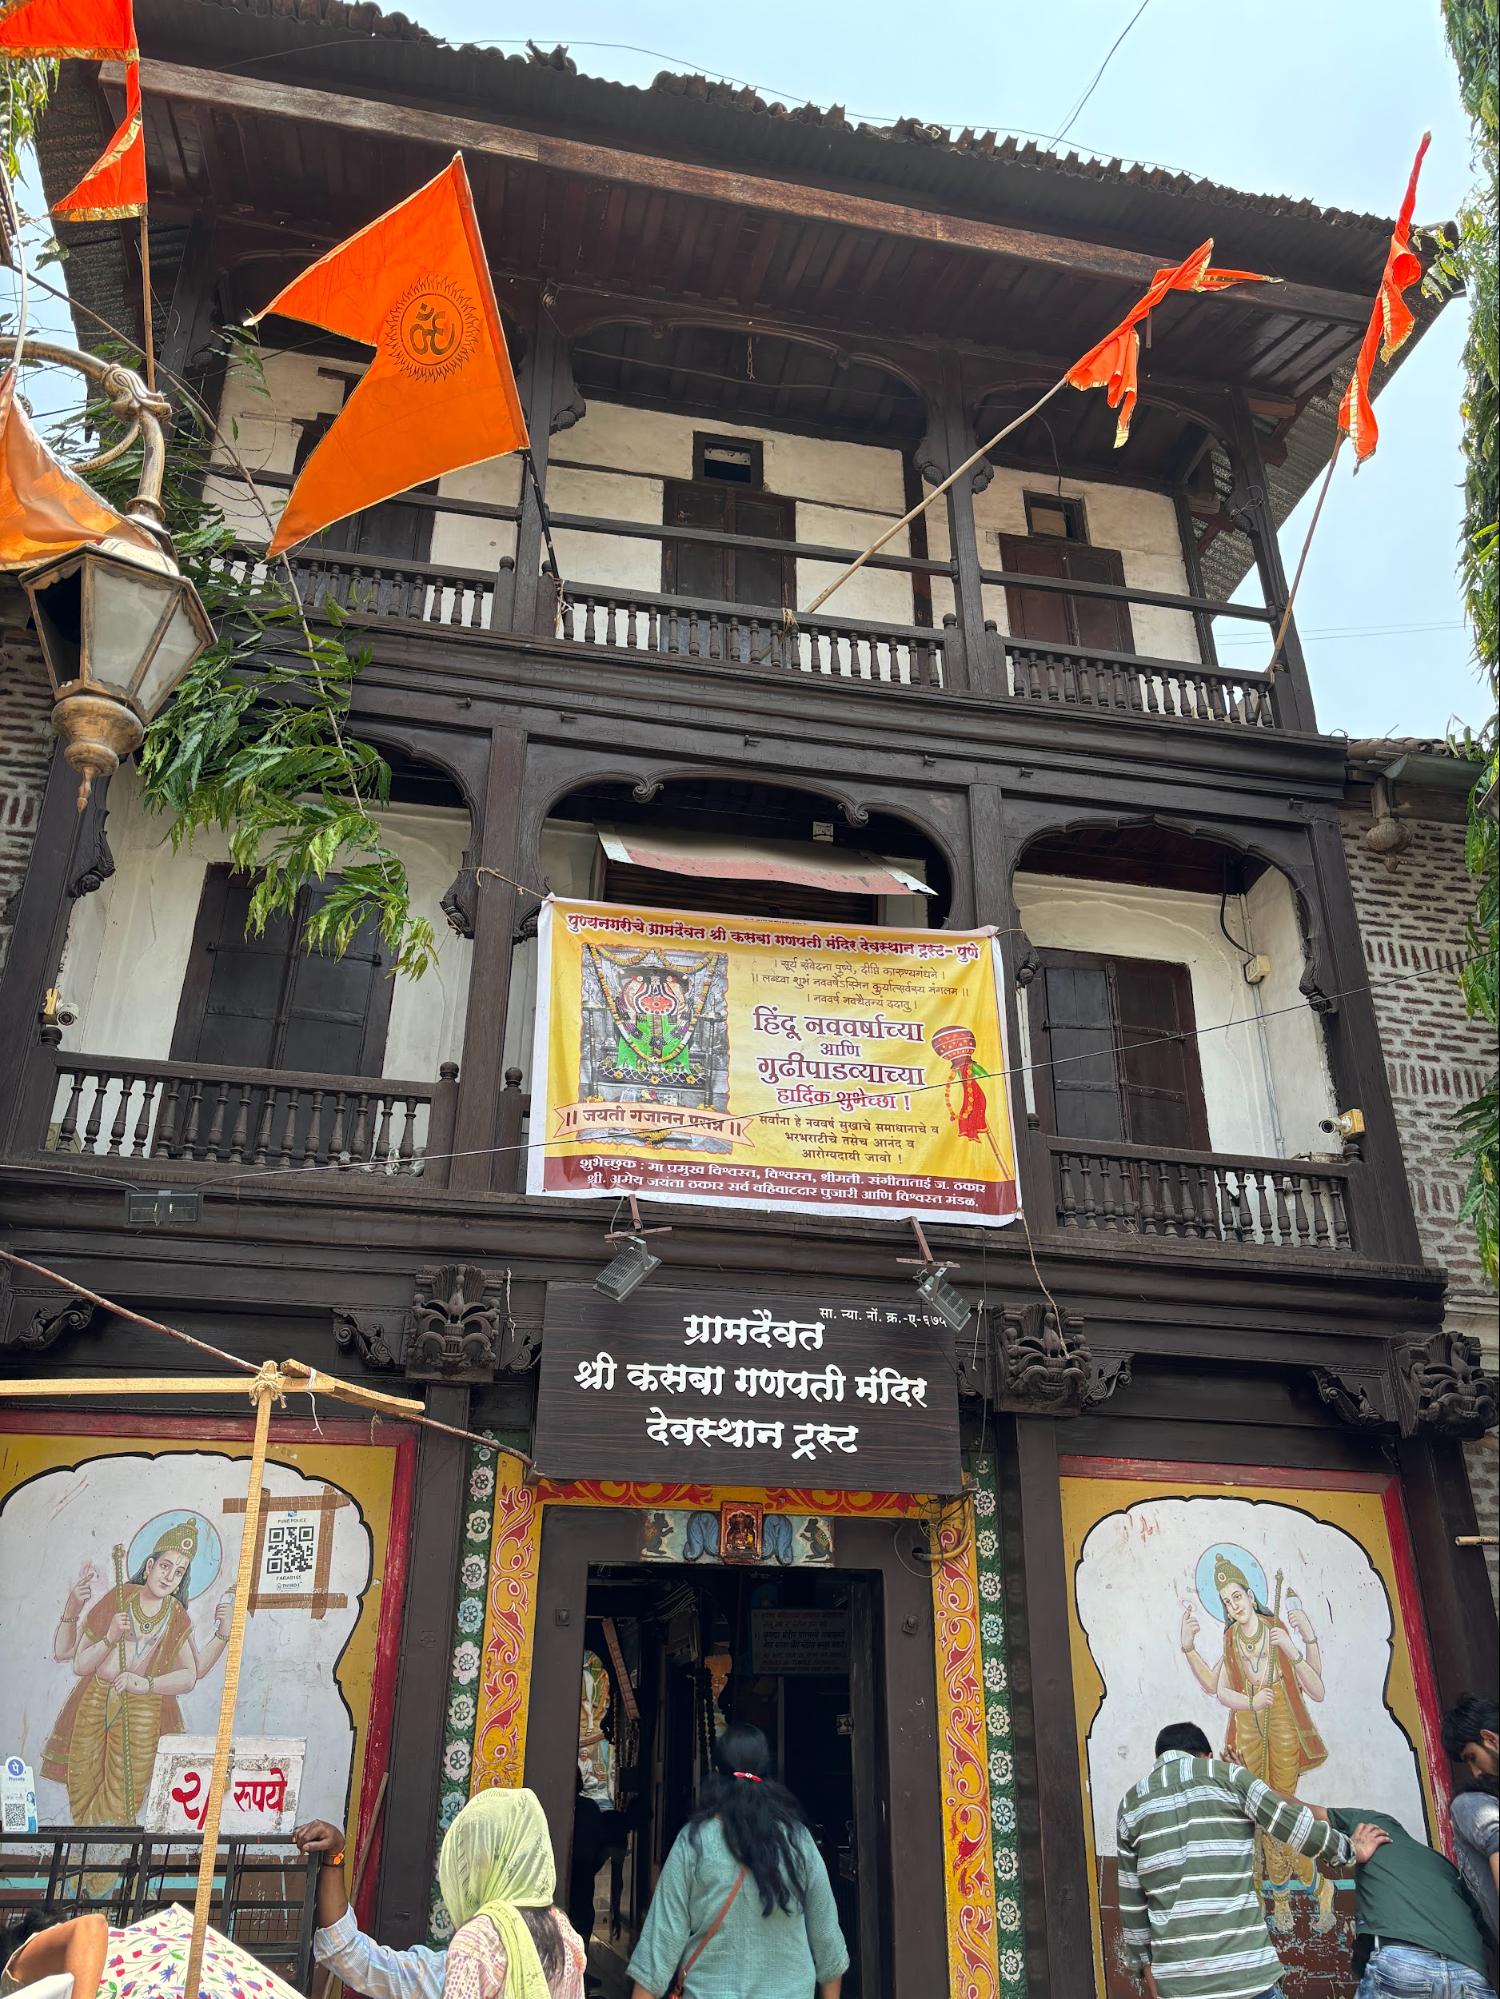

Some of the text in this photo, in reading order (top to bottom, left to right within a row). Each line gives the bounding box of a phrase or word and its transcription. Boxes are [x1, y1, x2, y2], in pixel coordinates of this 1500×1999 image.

[568, 914, 644, 932] पुण्यनगरीचे
[648, 921, 705, 939] ग्रामदैवत
[710, 926, 726, 941] श्री
[731, 931, 771, 944] कसबा
[774, 933, 821, 949] गणपती
[826, 936, 856, 951] मंदिर
[860, 936, 914, 955] देवस्थान
[957, 943, 979, 961] पुणे
[781, 957, 797, 973] सूर्य
[793, 973, 810, 989] शुभं
[753, 1006, 924, 1041] हिंदू नववर्षाच्या
[820, 1040, 861, 1057] आणि
[757, 1052, 925, 1086] गुढीपाडव्याच्या
[776, 1084, 831, 1104] हार्दिक
[836, 1088, 896, 1111] शुभेच्छा
[583, 1106, 626, 1122] जयती
[630, 1110, 686, 1125] गजानन
[794, 1115, 801, 1127] हे
[806, 1117, 835, 1129] नववर्ष
[839, 1119, 871, 1133] सुखाचे
[876, 1122, 927, 1134] समाधानाचे
[931, 1126, 939, 1134] व
[785, 1131, 915, 1149] भरभराटीचे तसेच आनंद व
[802, 1147, 860, 1162] आरोग्यदायी
[865, 1151, 891, 1163] जावो
[580, 1156, 637, 1171] शुभेच्छुक
[648, 1162, 664, 1172] मा
[667, 1164, 705, 1176] प्रमुख
[821, 1171, 864, 1185] श्रीमती.
[868, 1174, 932, 1189] संगीताताई
[953, 1182, 986, 1193] ठकार
[587, 1172, 606, 1184] श्री.
[610, 1172, 643, 1185] अमेय
[688, 1180, 723, 1190] ठकार
[727, 1181, 750, 1192] सर्व
[753, 1182, 817, 1195] वहिवाटदार
[821, 1186, 858, 1199] पुजारी
[862, 1188, 892, 1200] आणि
[896, 1190, 941, 1203] विश्वस्त
[945, 1193, 979, 1207] मंडळ.
[819, 1307, 837, 1319] सा.
[840, 1309, 862, 1321] न्या.
[683, 1309, 826, 1351] ग्रामदैवत
[574, 1351, 928, 1408] श्री कसबा गणपती मंदिर
[645, 1407, 859, 1461] देवस्थान ट्रस्ट
